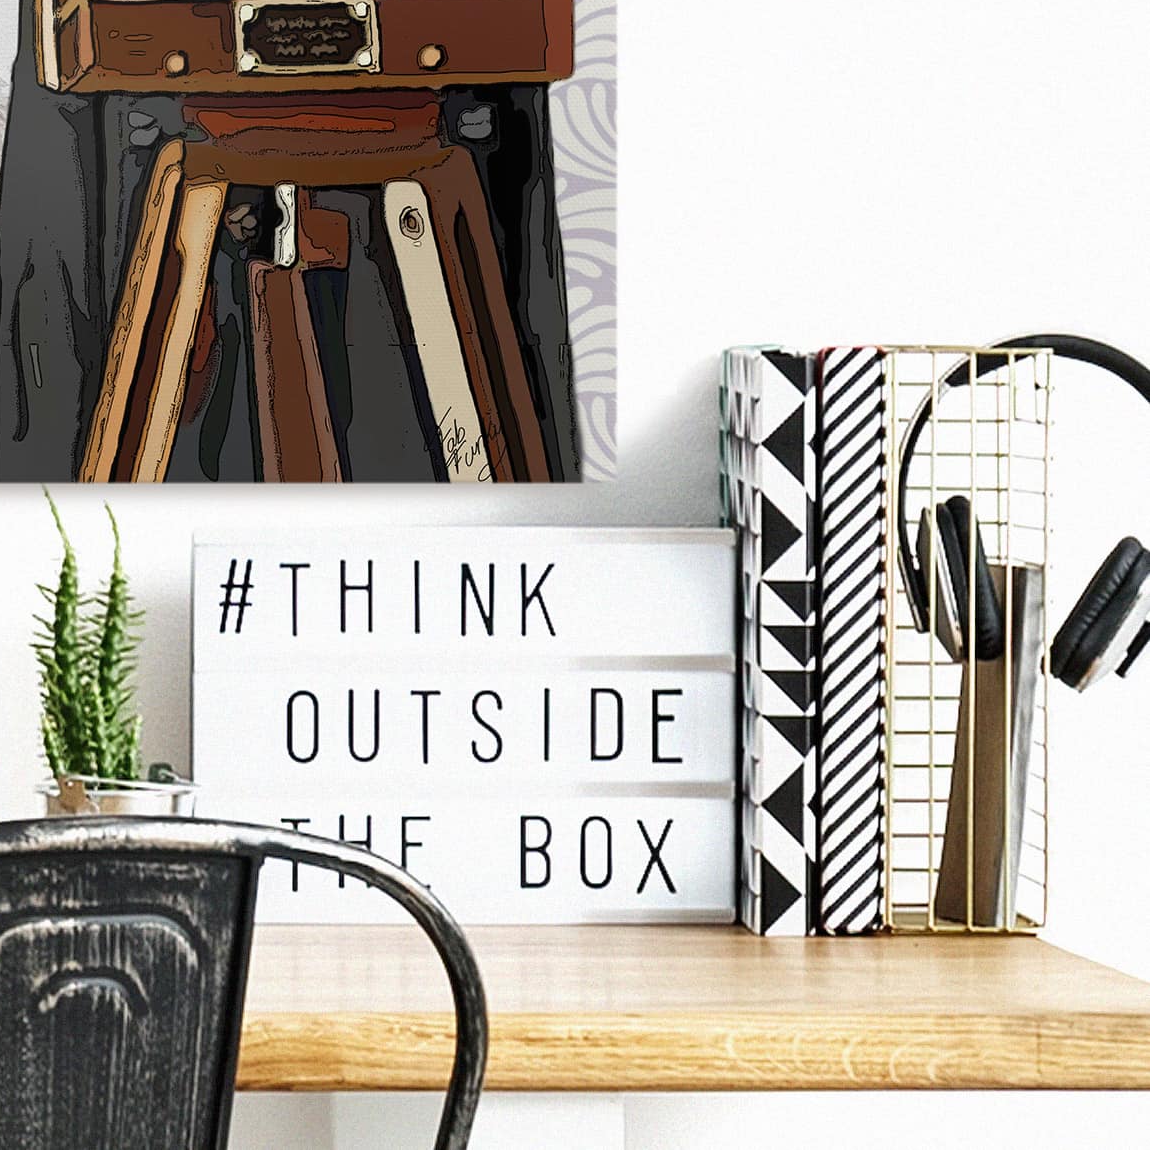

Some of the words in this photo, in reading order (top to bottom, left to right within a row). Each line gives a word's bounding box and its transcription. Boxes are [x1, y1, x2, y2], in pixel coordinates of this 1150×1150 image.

[219, 559, 556, 637] #THINK
[286, 687, 683, 765] OUTSIDE
[520, 815, 677, 895] BOX
